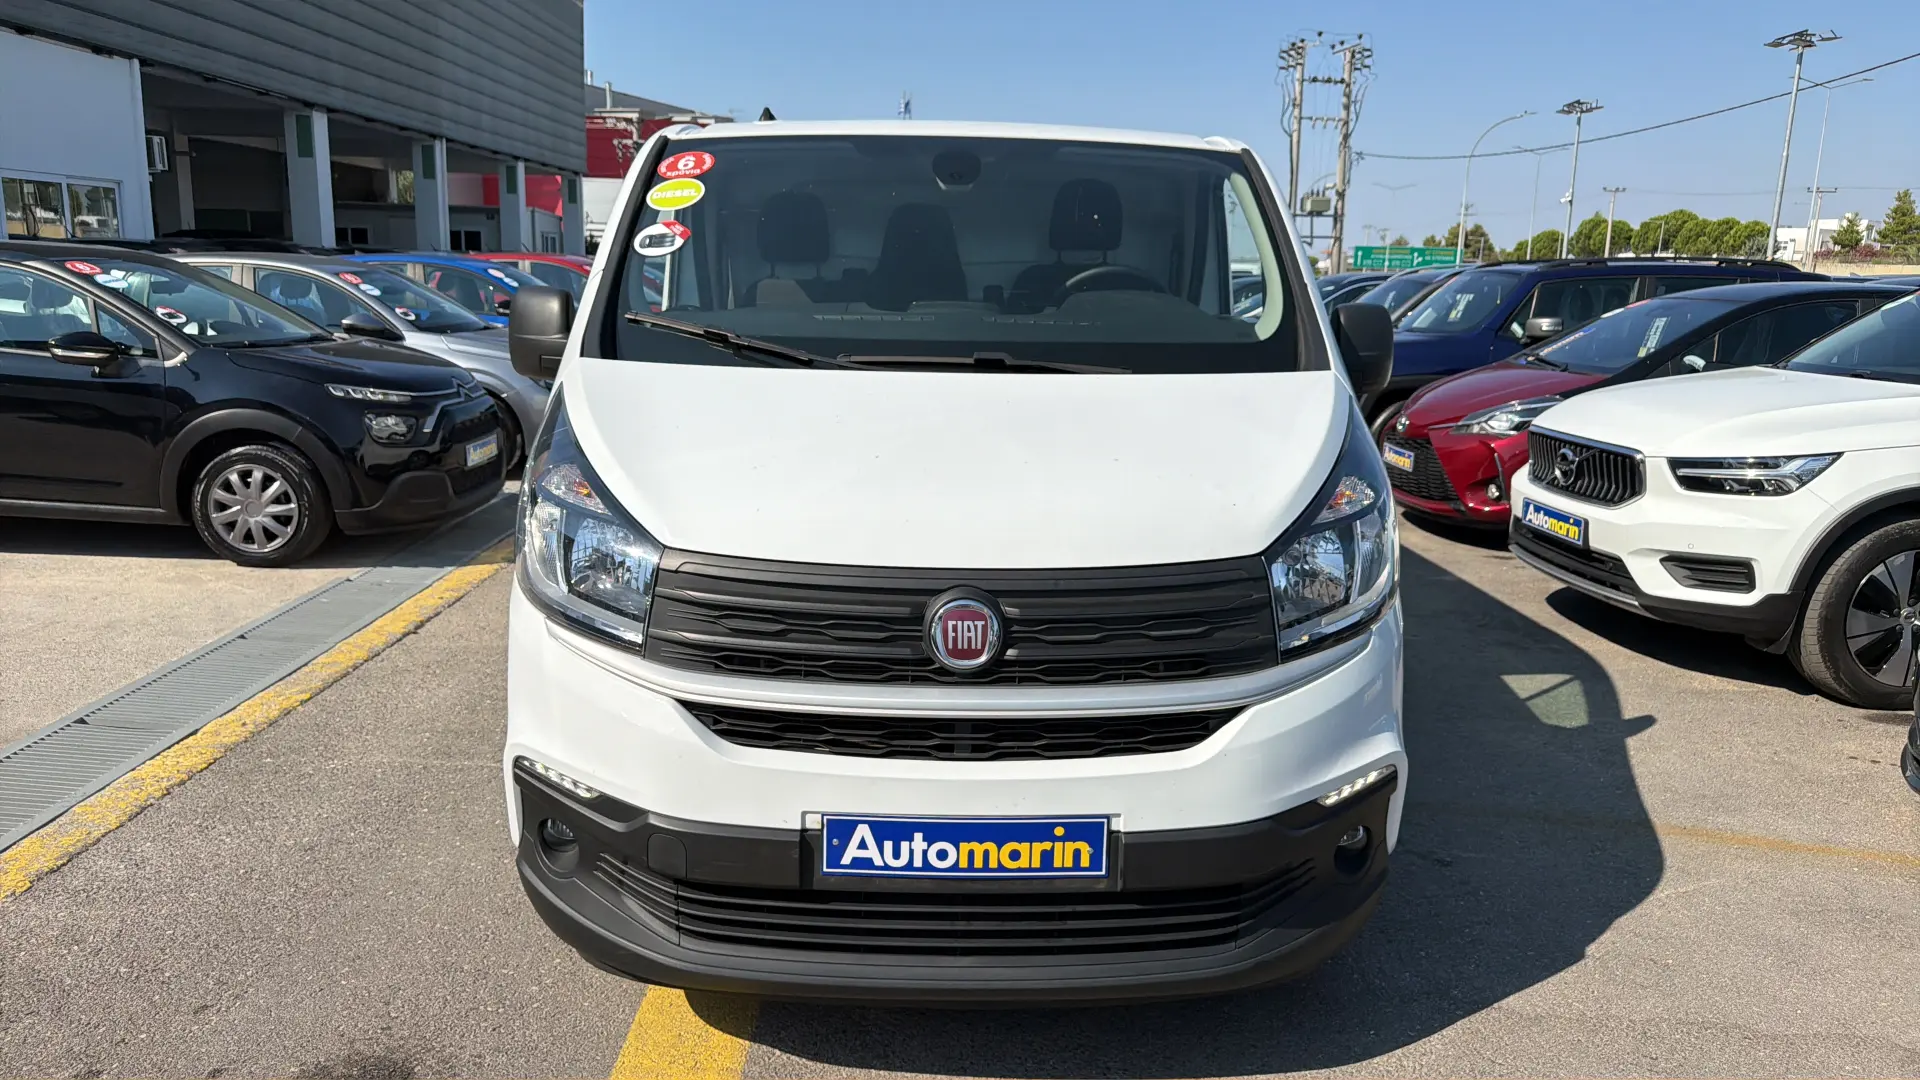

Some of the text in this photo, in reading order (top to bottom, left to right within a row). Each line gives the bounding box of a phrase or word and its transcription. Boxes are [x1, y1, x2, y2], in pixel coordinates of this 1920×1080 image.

[677, 156, 696, 170] 6
[651, 188, 699, 200] DIESEL
[1525, 503, 1579, 541] Automarin
[947, 621, 985, 650] FIAT
[840, 823, 1091, 869] Automarin
